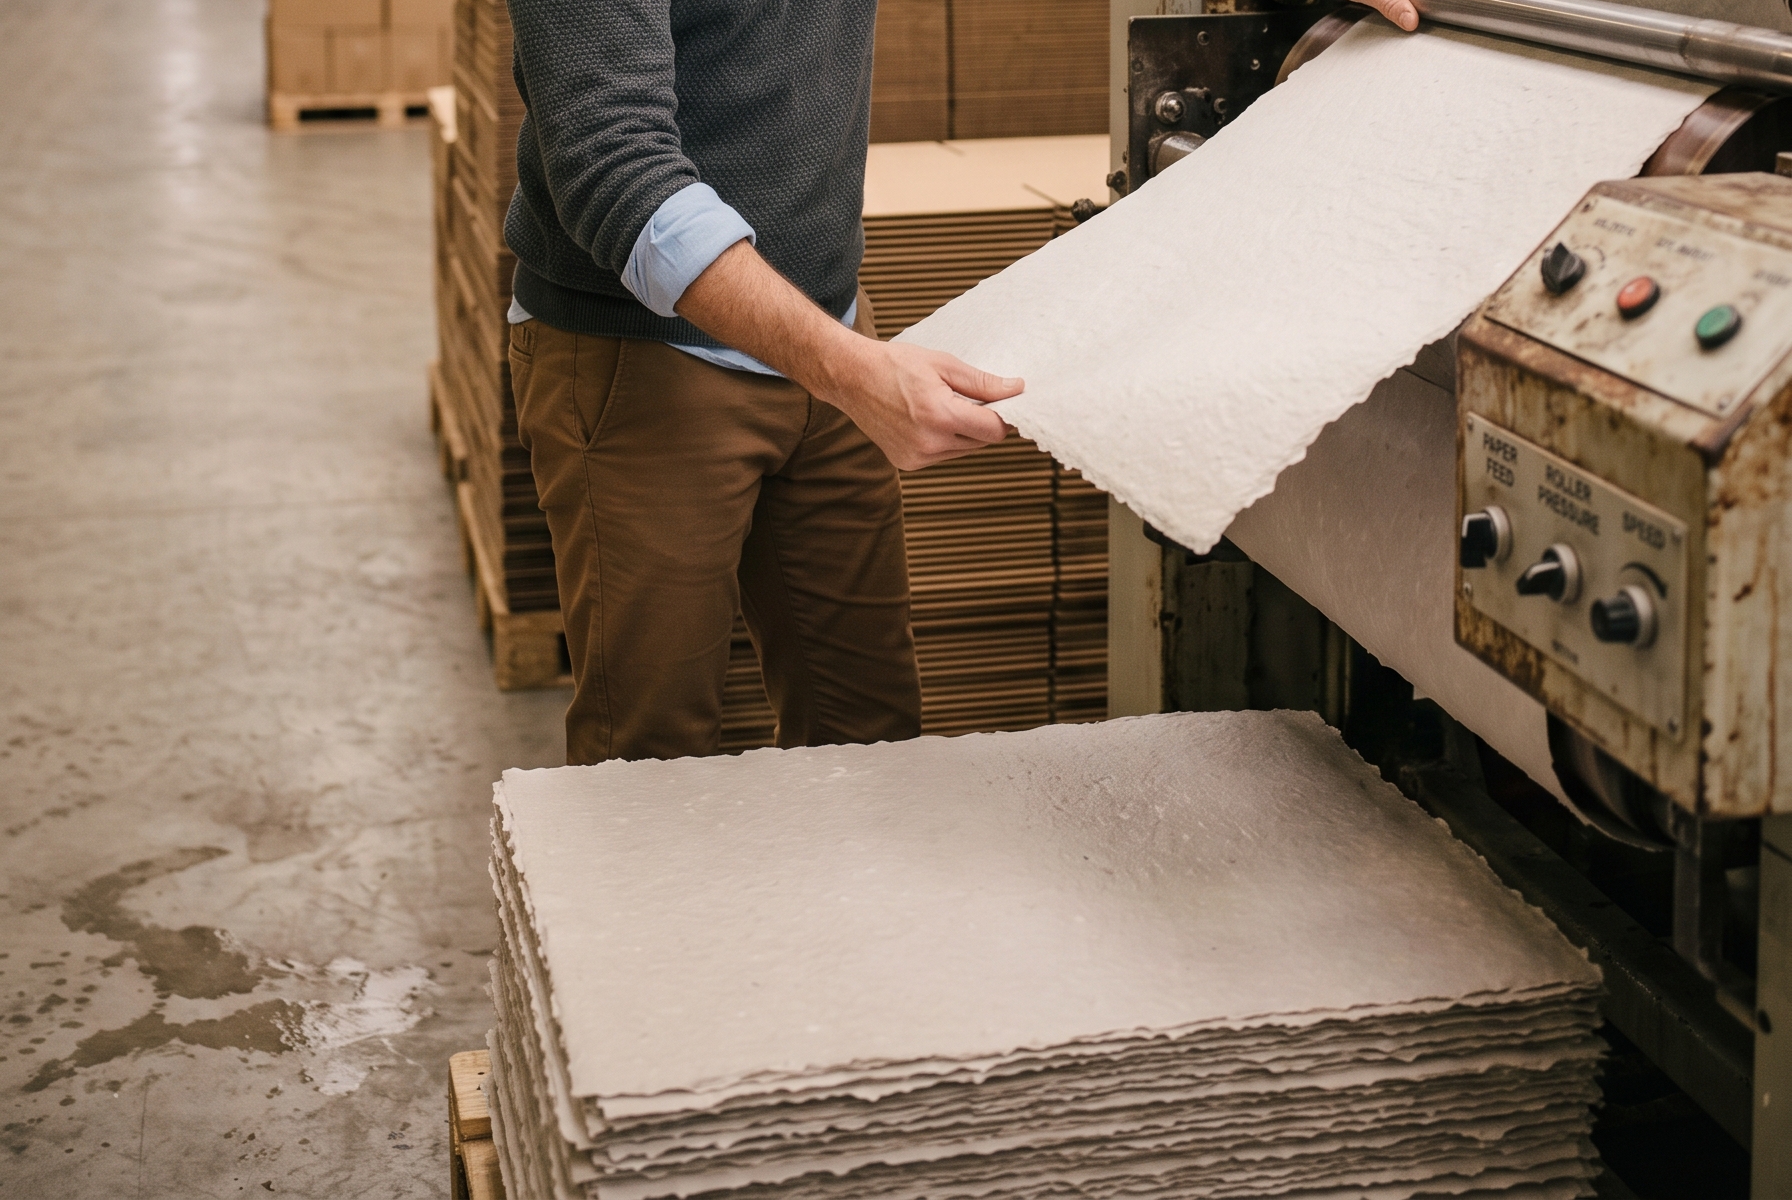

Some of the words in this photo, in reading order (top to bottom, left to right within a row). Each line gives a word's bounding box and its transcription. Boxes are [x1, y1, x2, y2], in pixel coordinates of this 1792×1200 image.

[1483, 432, 1518, 465] PAPER
[1486, 457, 1515, 487] FEED
[1545, 464, 1592, 500] ROLLER
[1538, 485, 1599, 536] PRESSURE
[1622, 511, 1666, 550] SPEED
